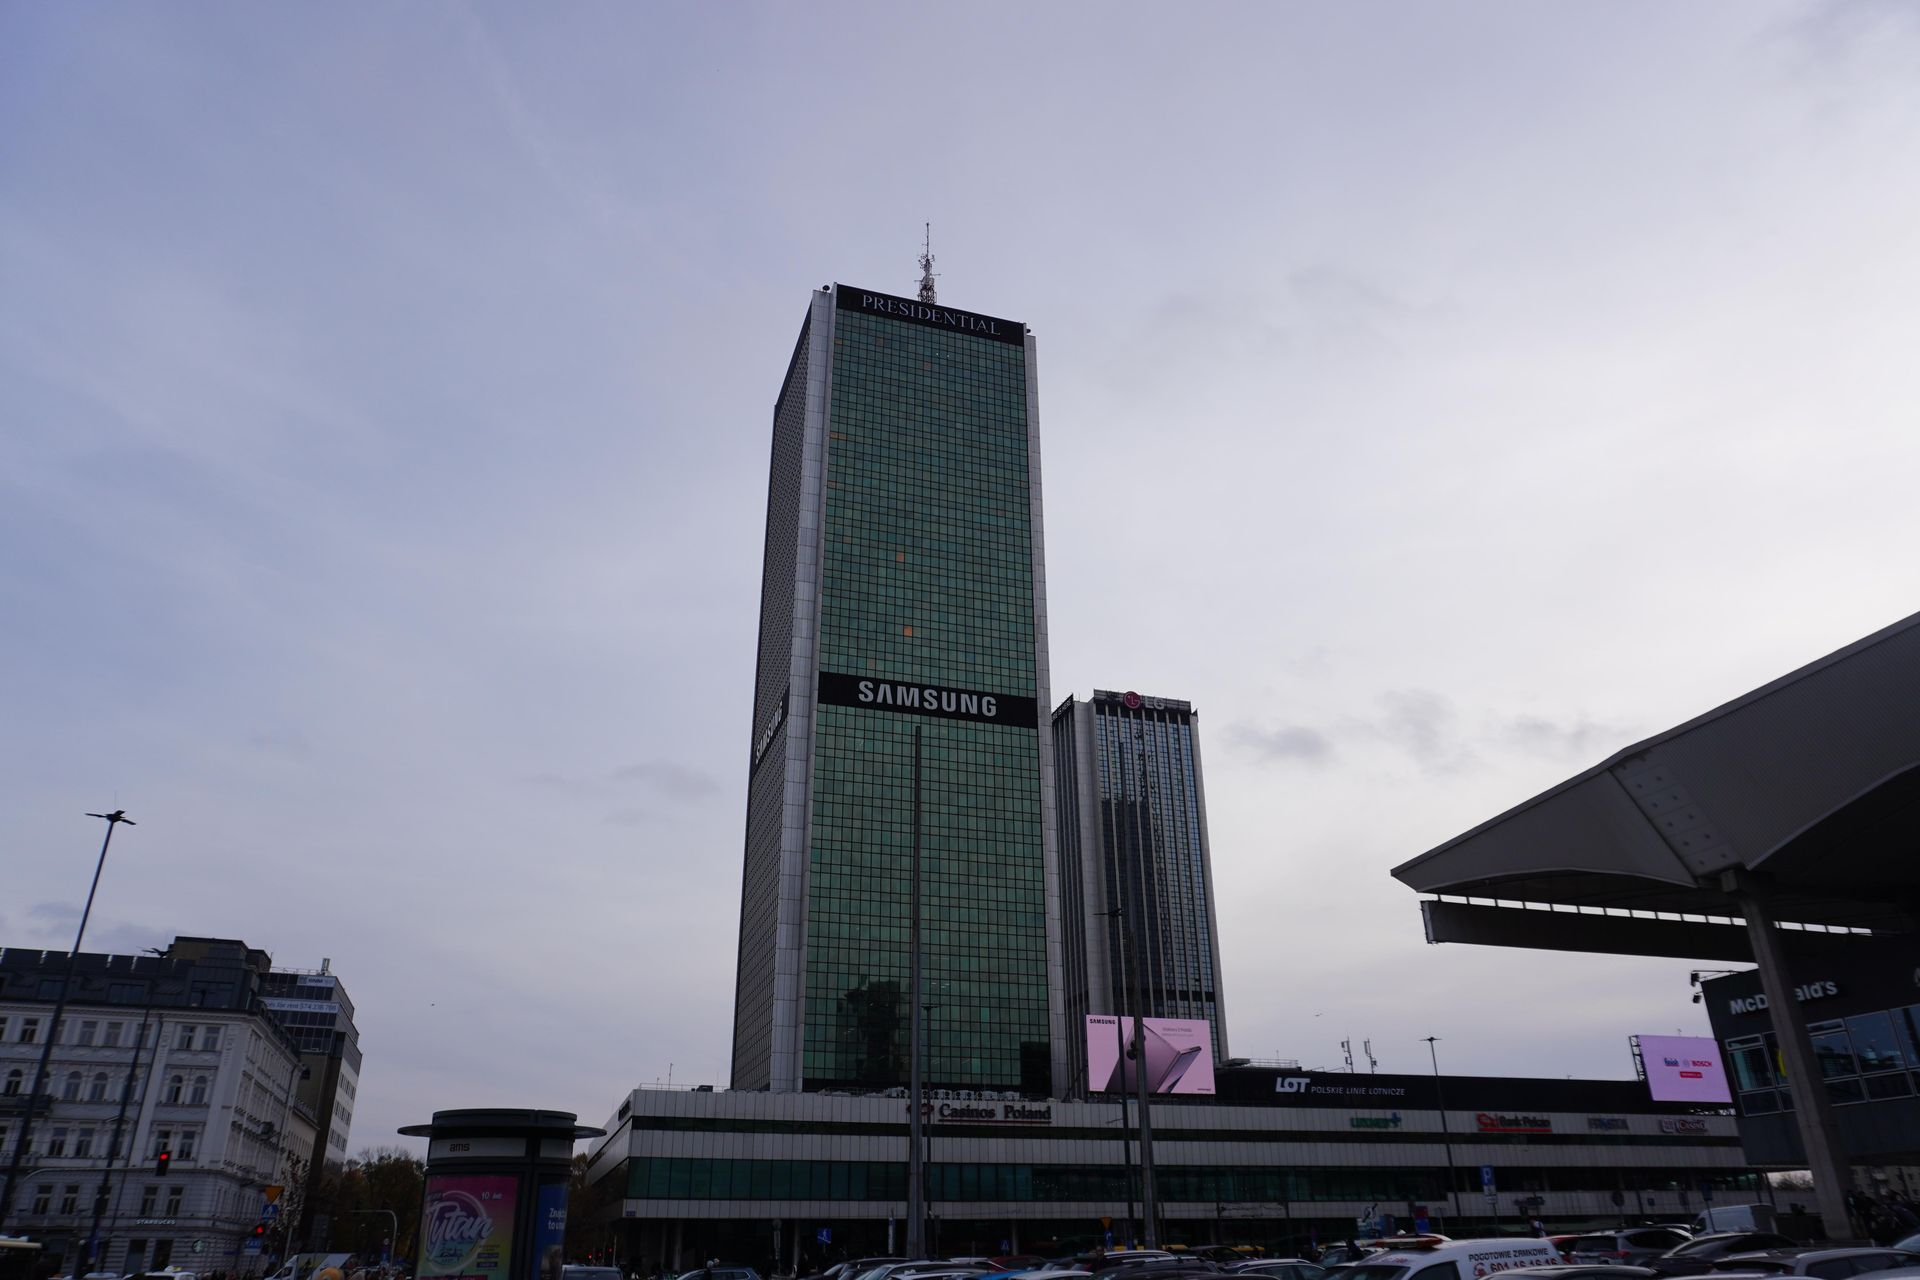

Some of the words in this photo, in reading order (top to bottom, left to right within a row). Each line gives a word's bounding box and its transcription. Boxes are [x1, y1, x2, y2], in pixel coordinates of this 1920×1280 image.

[862, 294, 1001, 336] PRESIDENTIAL
[858, 680, 997, 717] SAMSUNG
[1730, 980, 1839, 1015] McDald's
[1275, 1077, 1311, 1093] LOT
[1311, 1086, 1344, 1095] POLSKIE
[1346, 1087, 1366, 1095] LINIE
[1368, 1088, 1406, 1096] LOTNICZE
[939, 1103, 996, 1119] Casinos
[1004, 1105, 1052, 1120] Poland
[449, 1143, 470, 1152] ams
[1482, 1167, 1492, 1184] P
[1468, 1250, 1512, 1262] POGOTOWIE
[1512, 1247, 1549, 1258] ZAMKOWE
